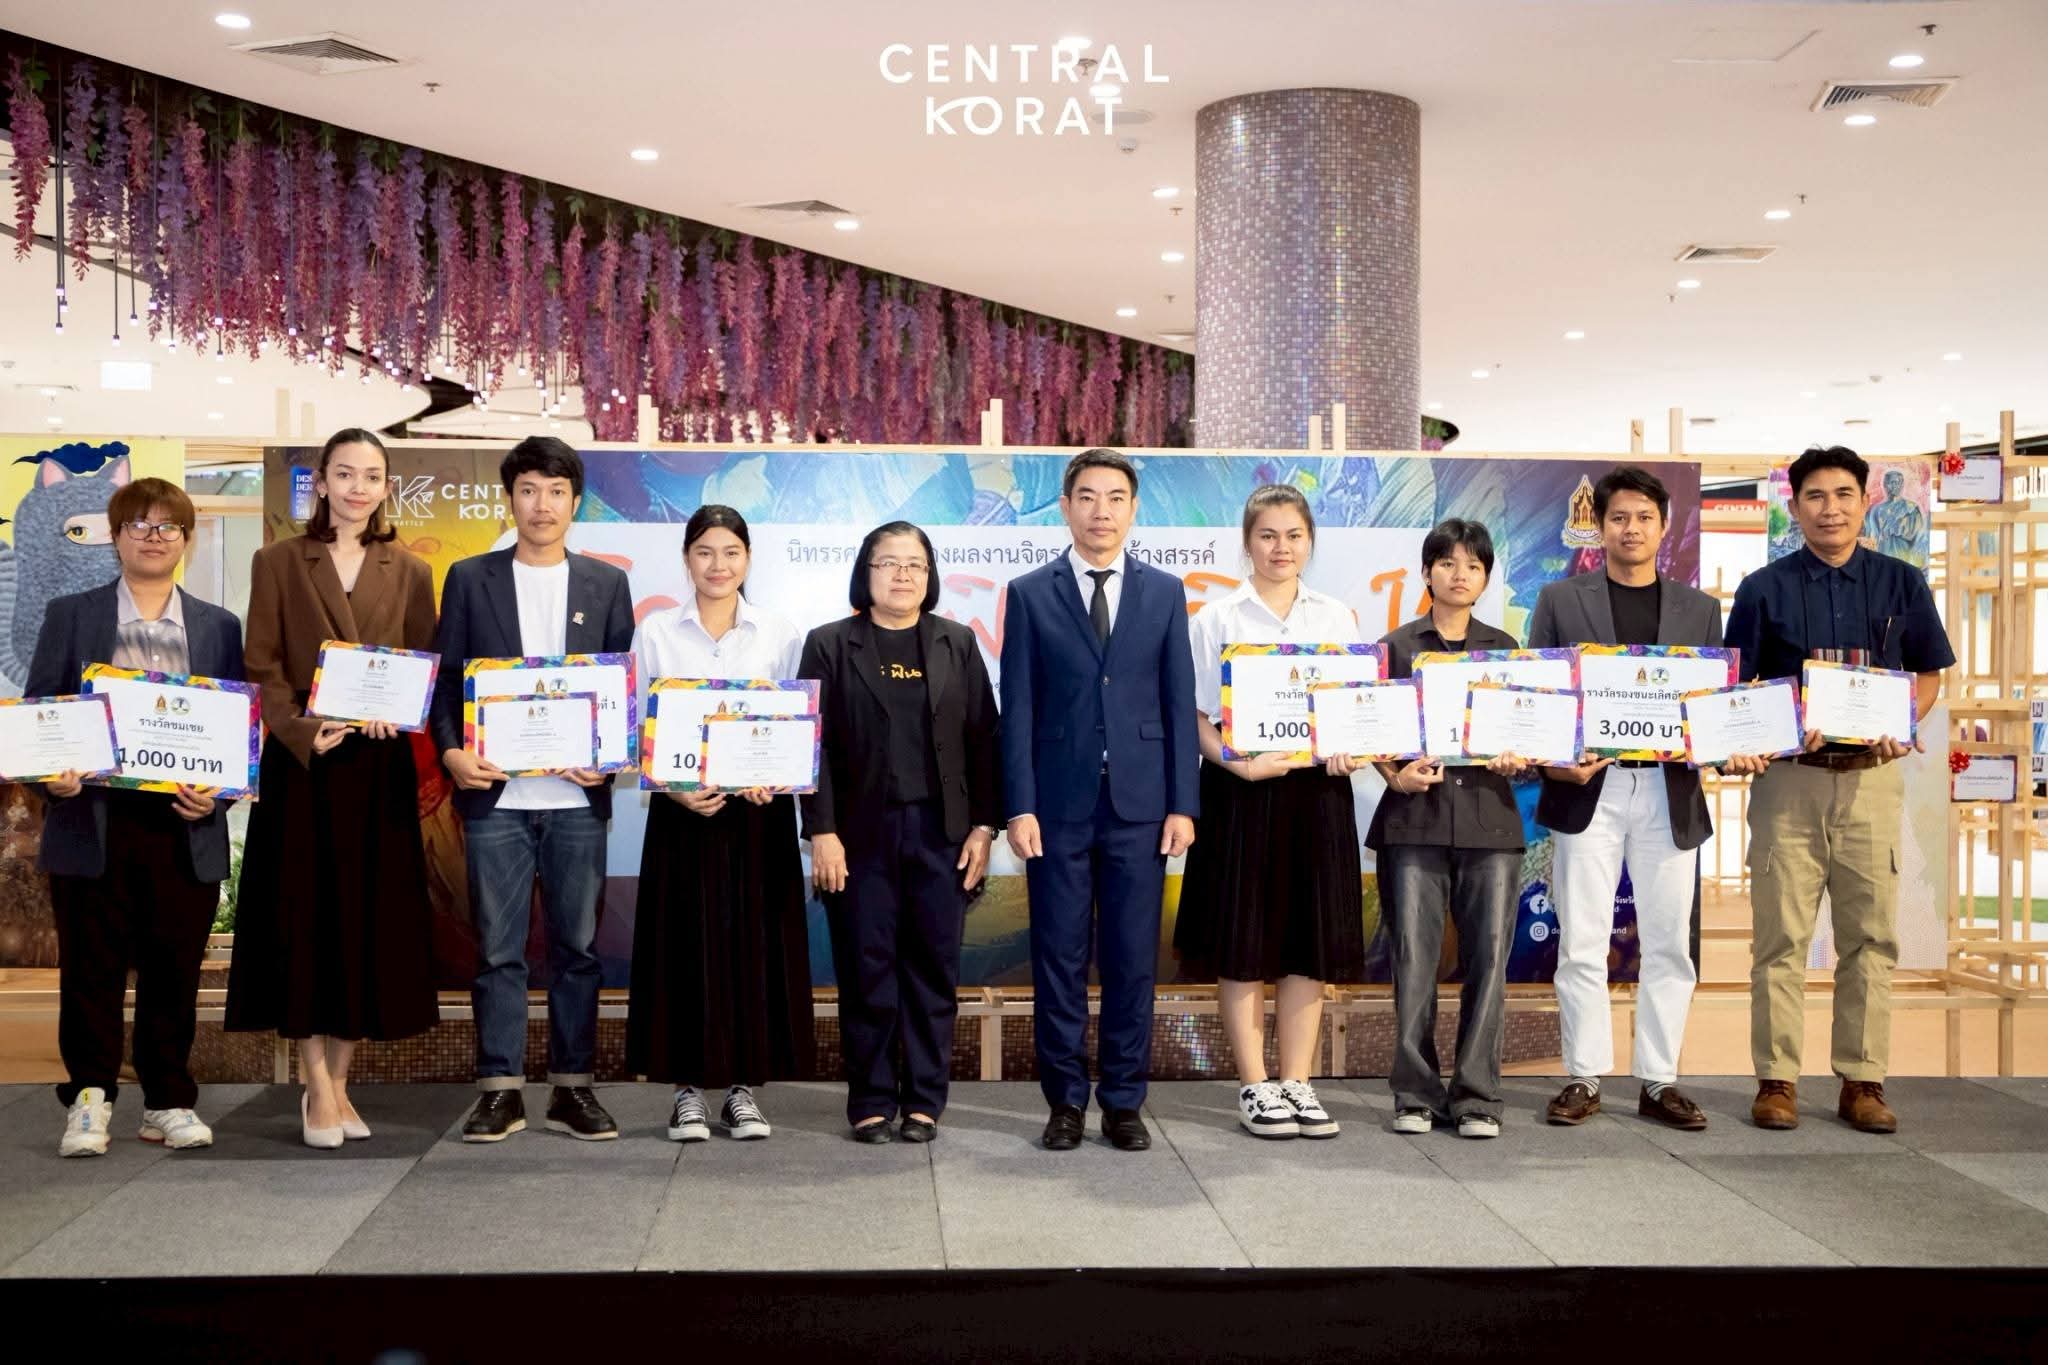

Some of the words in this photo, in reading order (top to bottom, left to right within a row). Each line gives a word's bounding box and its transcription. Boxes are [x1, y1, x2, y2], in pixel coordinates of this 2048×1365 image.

[441, 483, 505, 500] CENT
[459, 503, 514, 520] KOR
[1258, 721, 1311, 741] 1,000
[1600, 719, 1654, 739] 3,000
[1660, 724, 1684, 738] บา
[119, 747, 176, 768] 1,000
[182, 755, 223, 774] บาท
[673, 753, 702, 773] 10,
